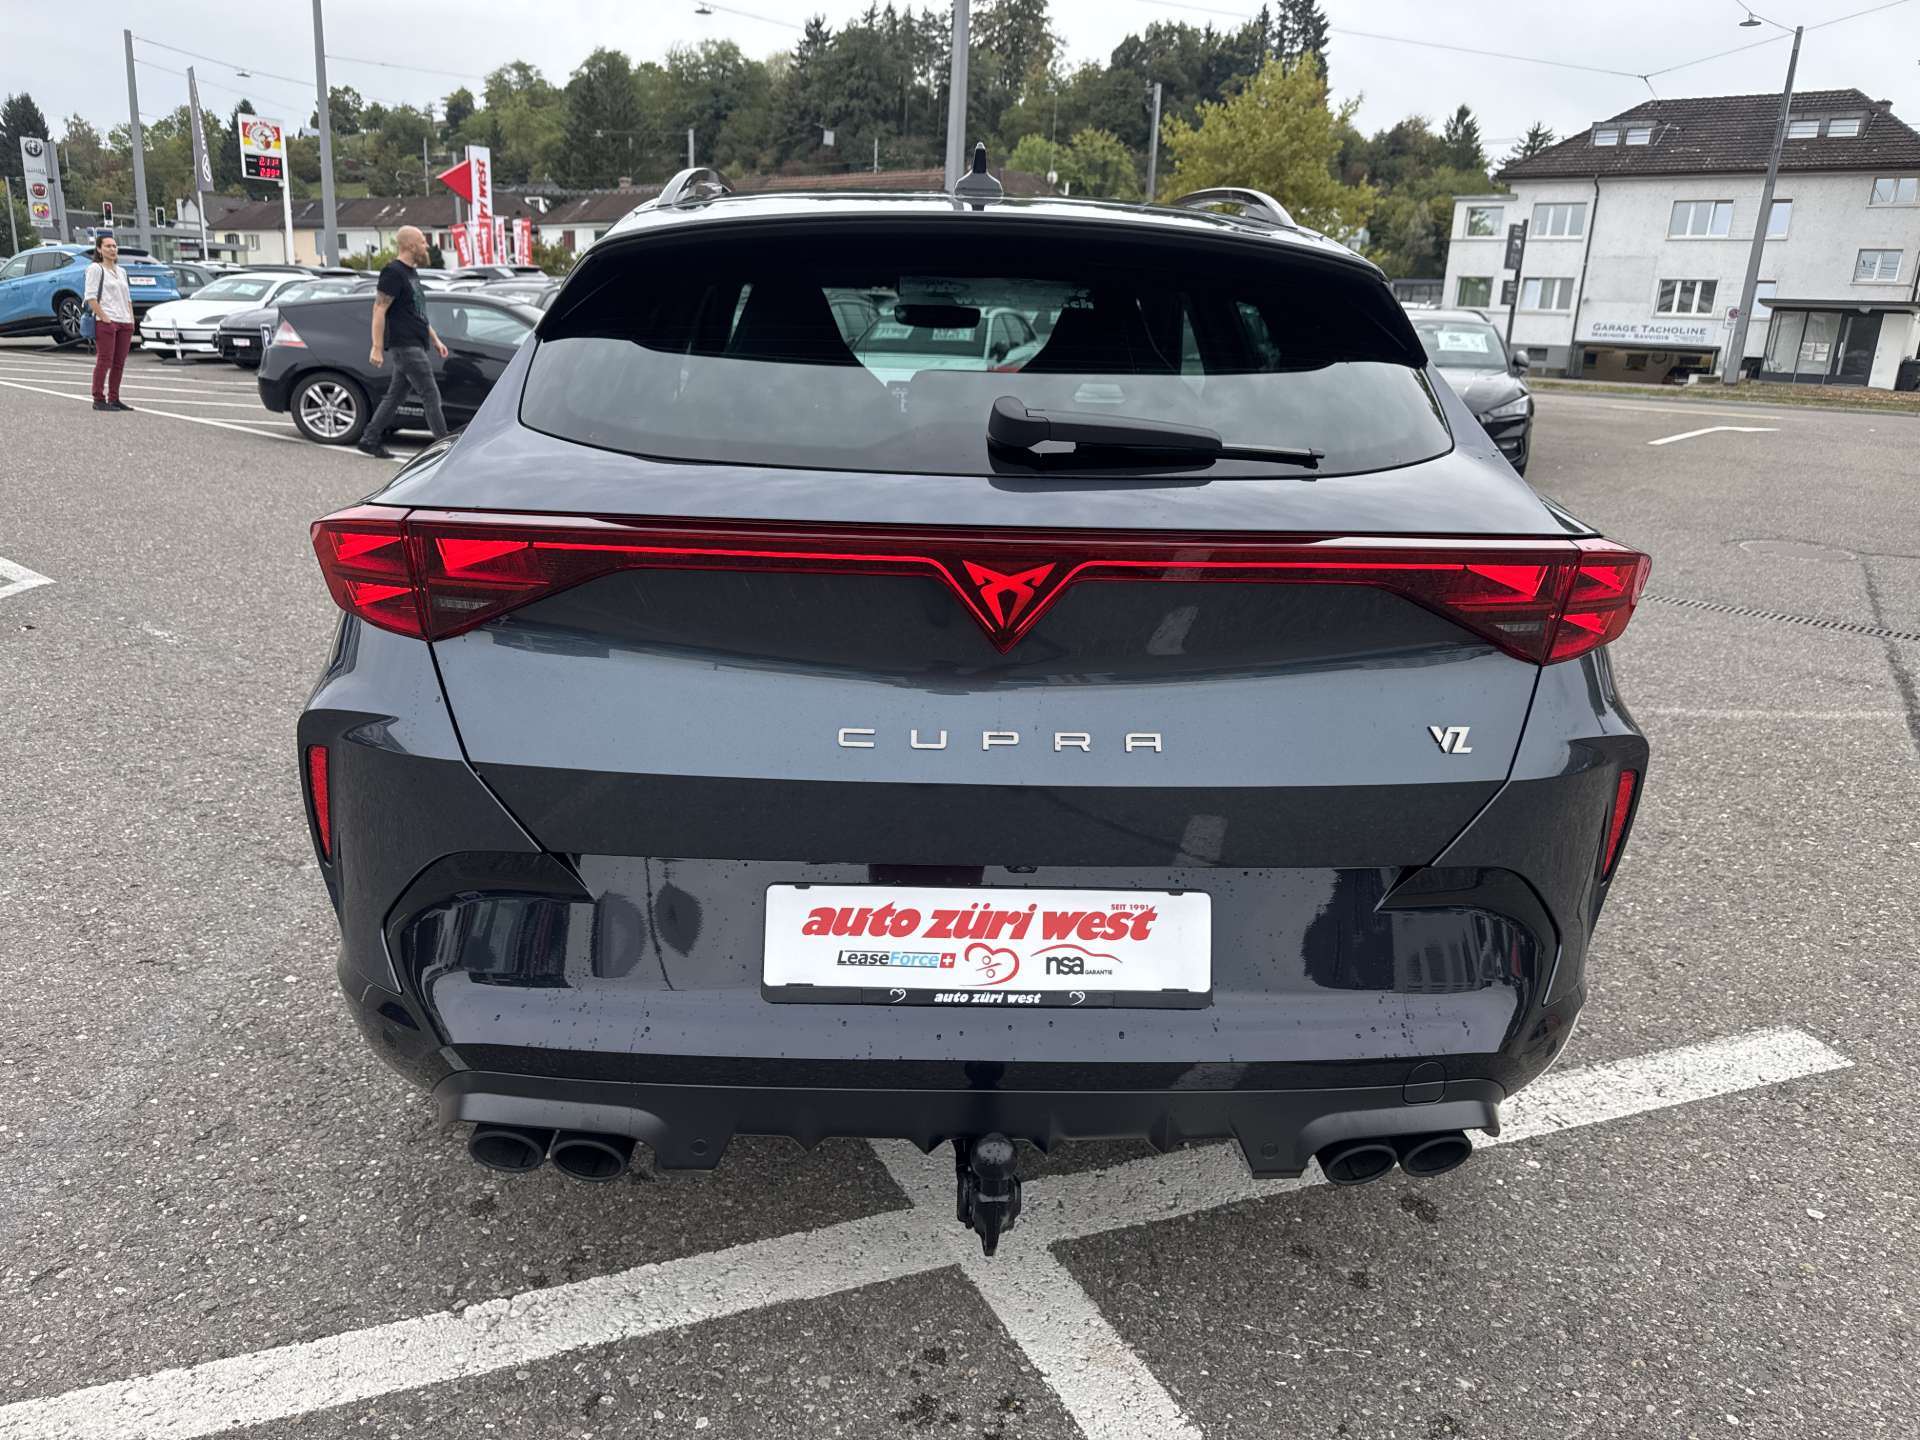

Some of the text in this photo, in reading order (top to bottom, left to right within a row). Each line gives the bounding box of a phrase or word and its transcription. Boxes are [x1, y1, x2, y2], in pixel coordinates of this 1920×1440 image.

[1592, 322, 1707, 336] GARAGE TACHOLINE
[838, 728, 1162, 752] CUPRA
[1427, 726, 1473, 754] VZ
[802, 901, 1158, 941] auto züri west
[837, 950, 939, 967] LeaseForce
[1045, 956, 1084, 975] nsa
[934, 991, 1041, 1004] auto züri west
